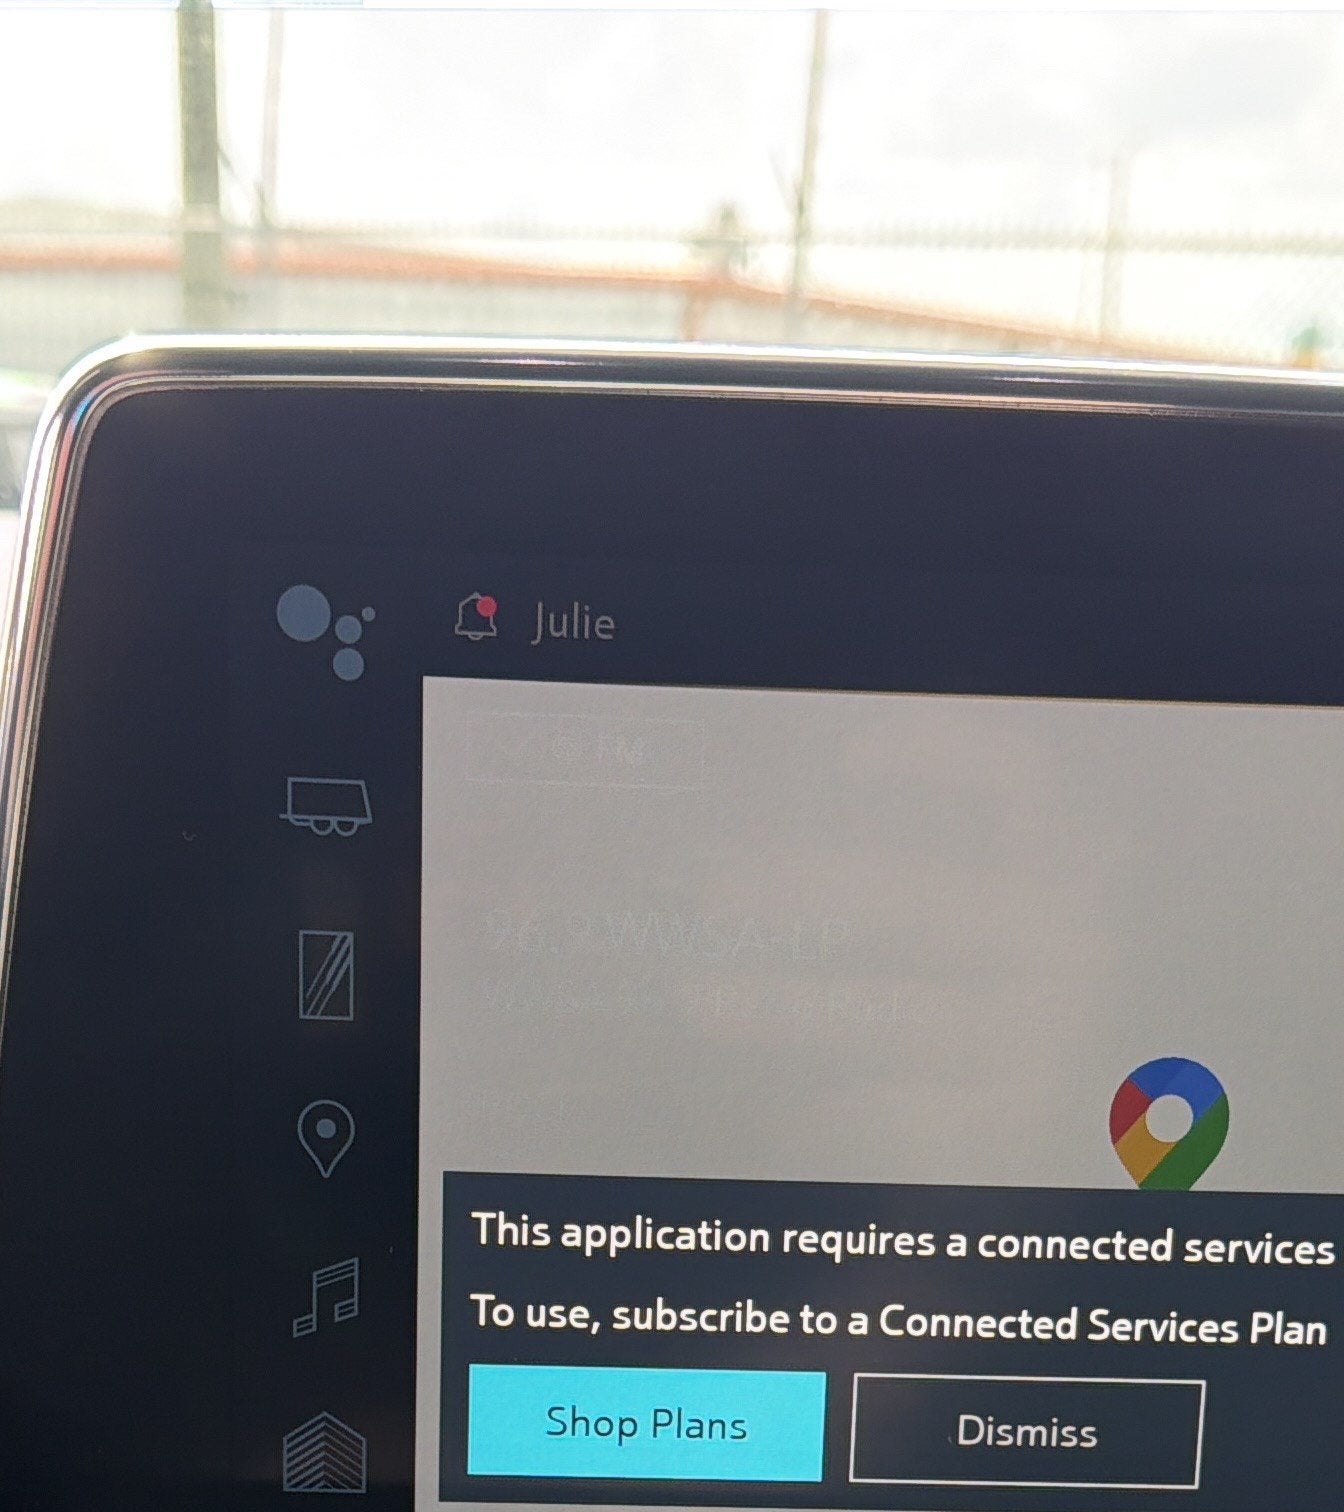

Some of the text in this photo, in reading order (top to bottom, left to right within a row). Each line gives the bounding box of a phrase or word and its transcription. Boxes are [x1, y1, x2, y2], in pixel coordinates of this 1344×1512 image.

[530, 601, 615, 645] Julie
[470, 1210, 551, 1247] This
[561, 1214, 770, 1258] application
[783, 1222, 936, 1264] requires
[946, 1234, 968, 1257] a
[978, 1227, 1174, 1262] connected
[1183, 1232, 1336, 1265] services
[469, 1293, 1327, 1346] To use, subscribe to a Connected Services Plan
[546, 1404, 747, 1447] Shop Plans
[958, 1414, 1098, 1448] Dismiss
